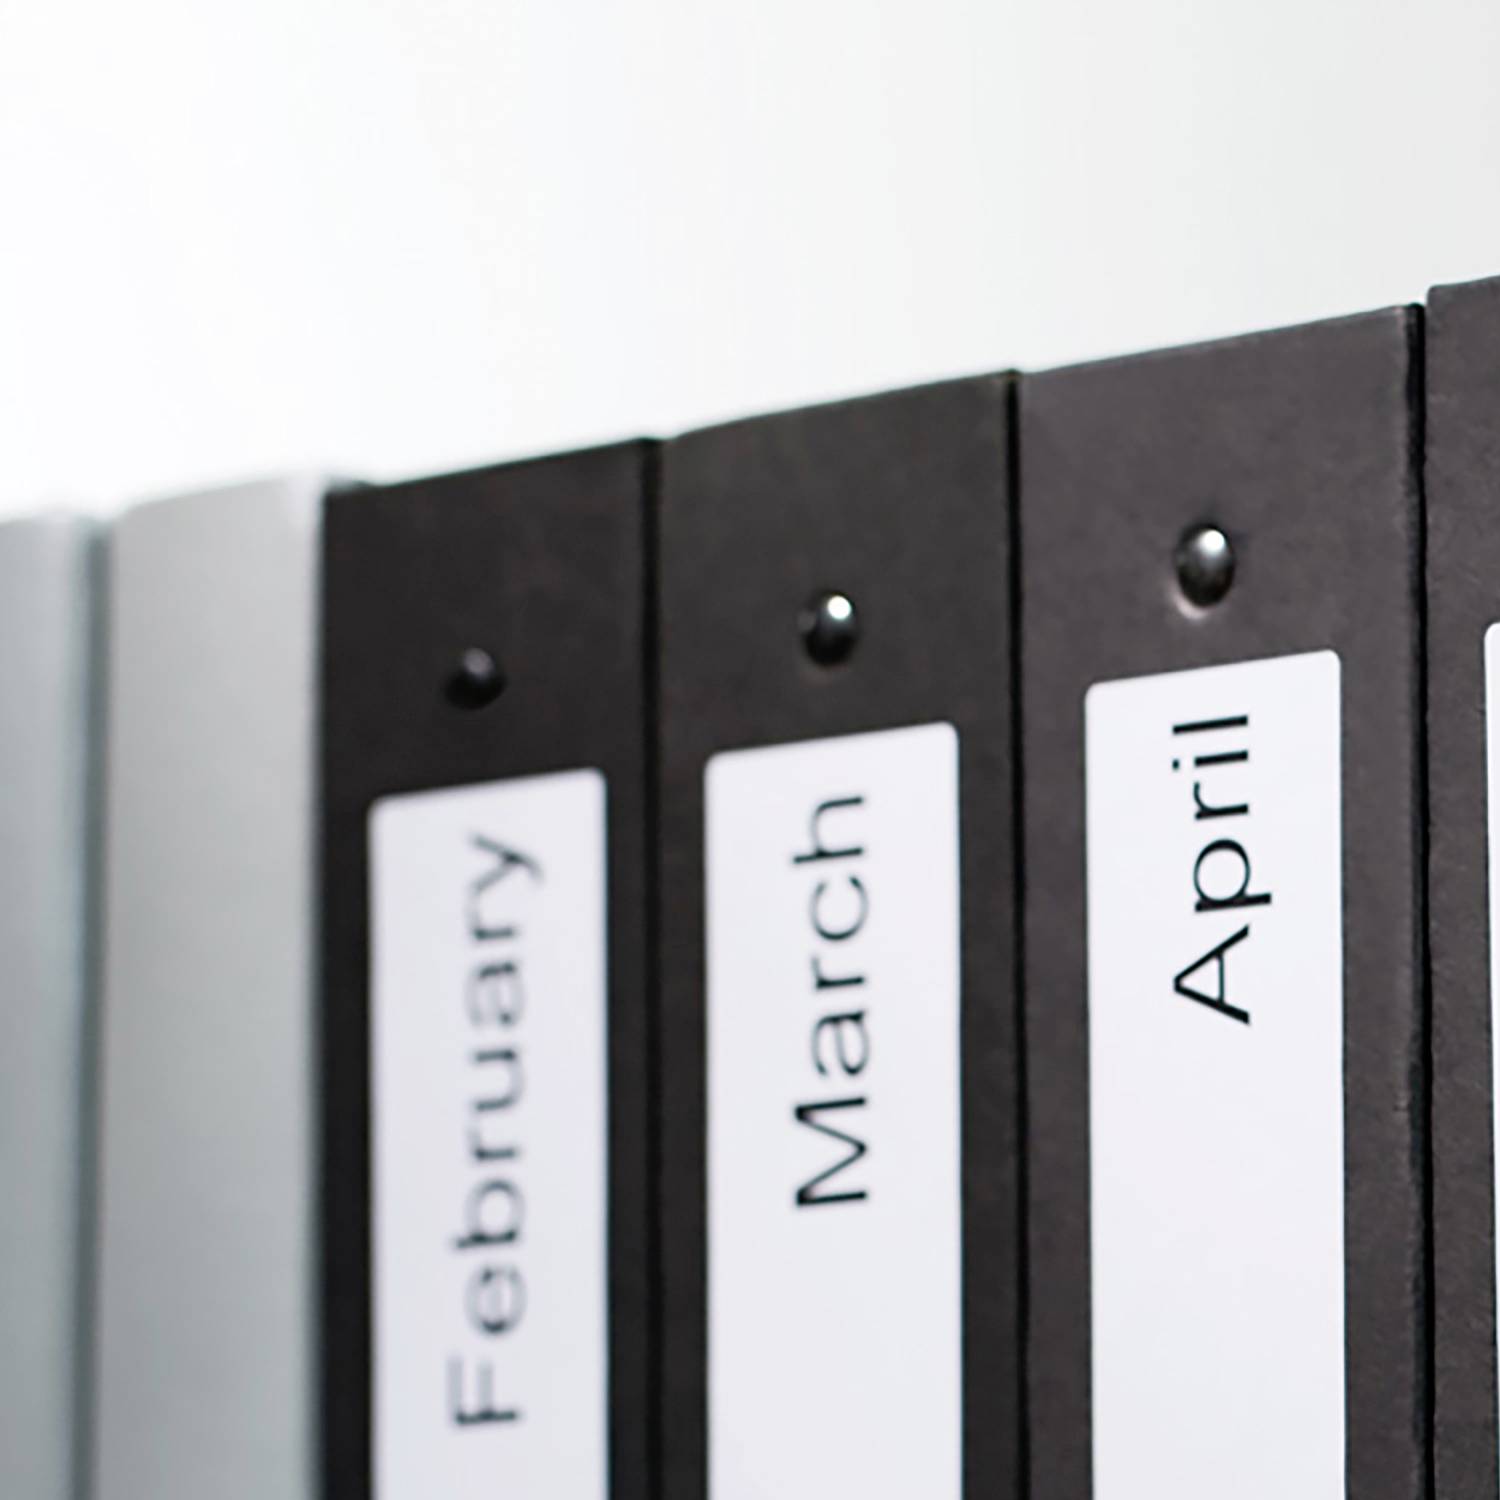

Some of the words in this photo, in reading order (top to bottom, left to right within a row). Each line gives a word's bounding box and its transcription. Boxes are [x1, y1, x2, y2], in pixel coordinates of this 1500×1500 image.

[792, 795, 869, 1209] March
[1172, 714, 1272, 1026] April
[447, 832, 544, 1429] February
